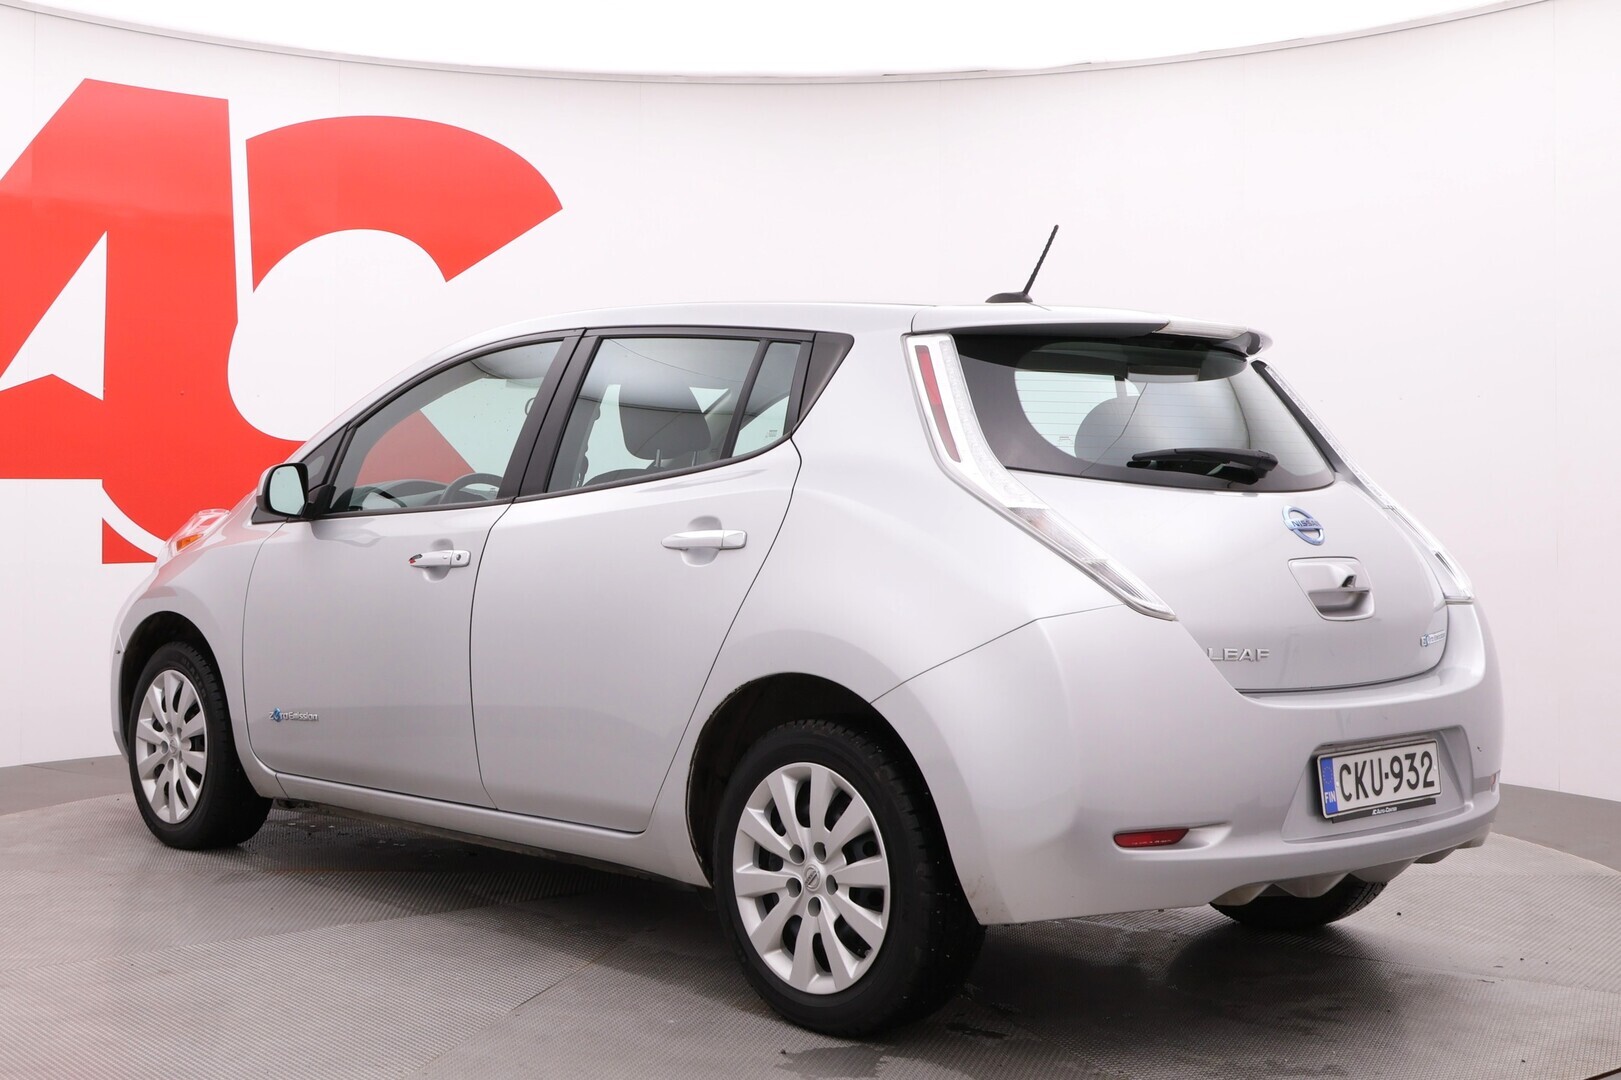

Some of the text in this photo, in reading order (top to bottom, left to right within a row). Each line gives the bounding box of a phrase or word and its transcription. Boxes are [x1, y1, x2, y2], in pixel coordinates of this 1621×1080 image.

[1207, 647, 1270, 662] LEAF
[1339, 750, 1436, 802] CKU-932
[1324, 790, 1336, 804] FIN
